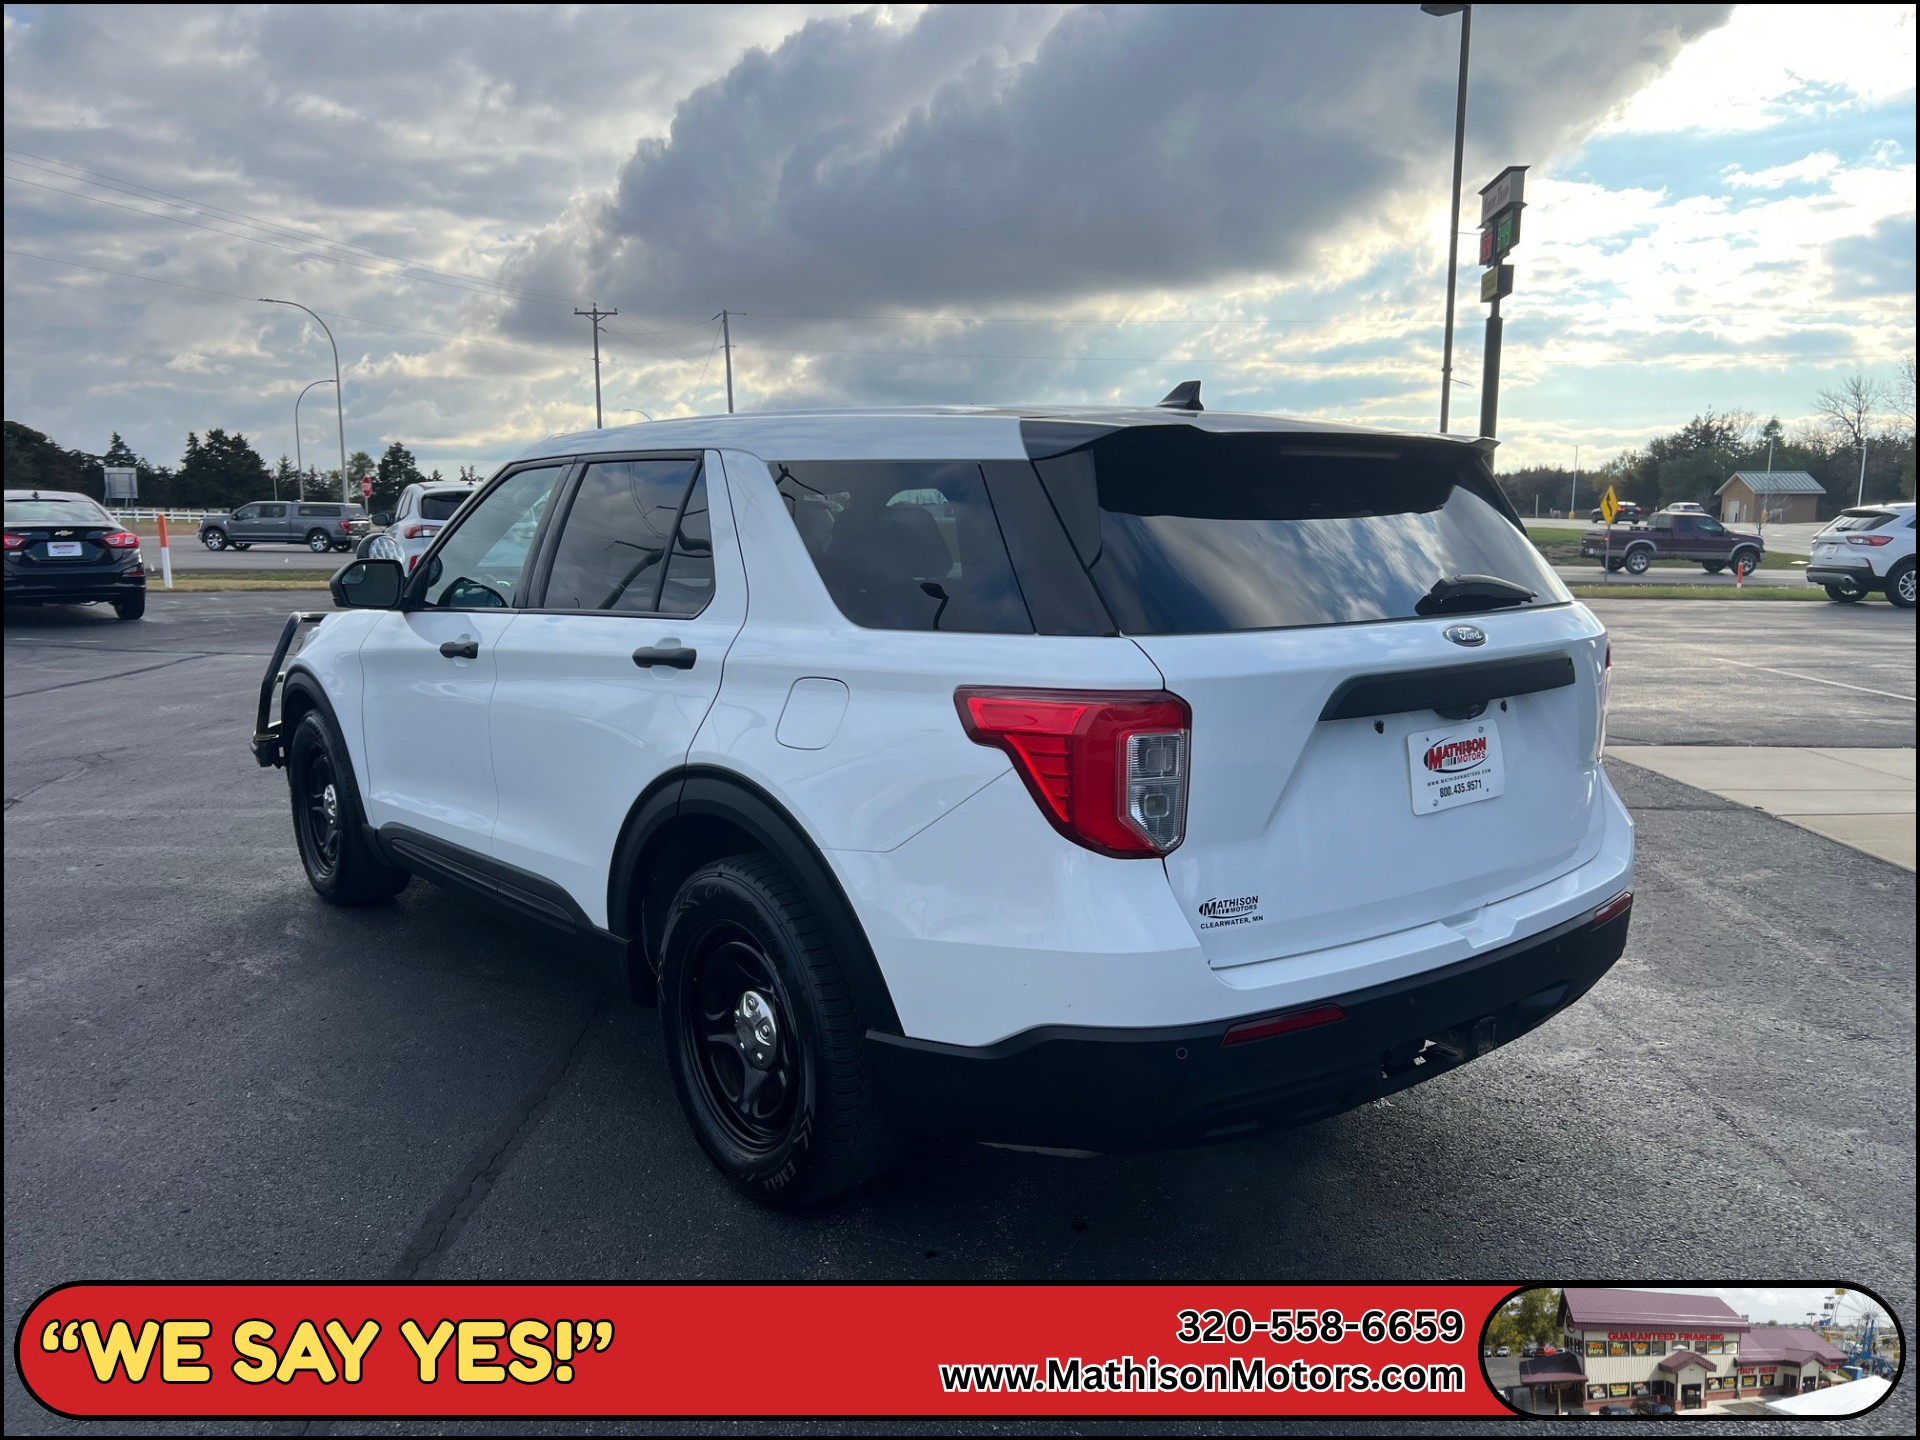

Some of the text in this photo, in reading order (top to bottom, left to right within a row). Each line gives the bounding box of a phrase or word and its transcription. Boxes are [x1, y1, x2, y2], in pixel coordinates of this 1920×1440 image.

[1458, 627, 1482, 640] Ford
[1428, 737, 1487, 771] MATHISON
[1456, 751, 1486, 764] MOTORS
[1440, 779, 1482, 798] 800.435.9571
[1203, 895, 1259, 916] MATHISON
[1230, 904, 1257, 913] MOTORS
[1200, 917, 1251, 930] CLEARWATER,
